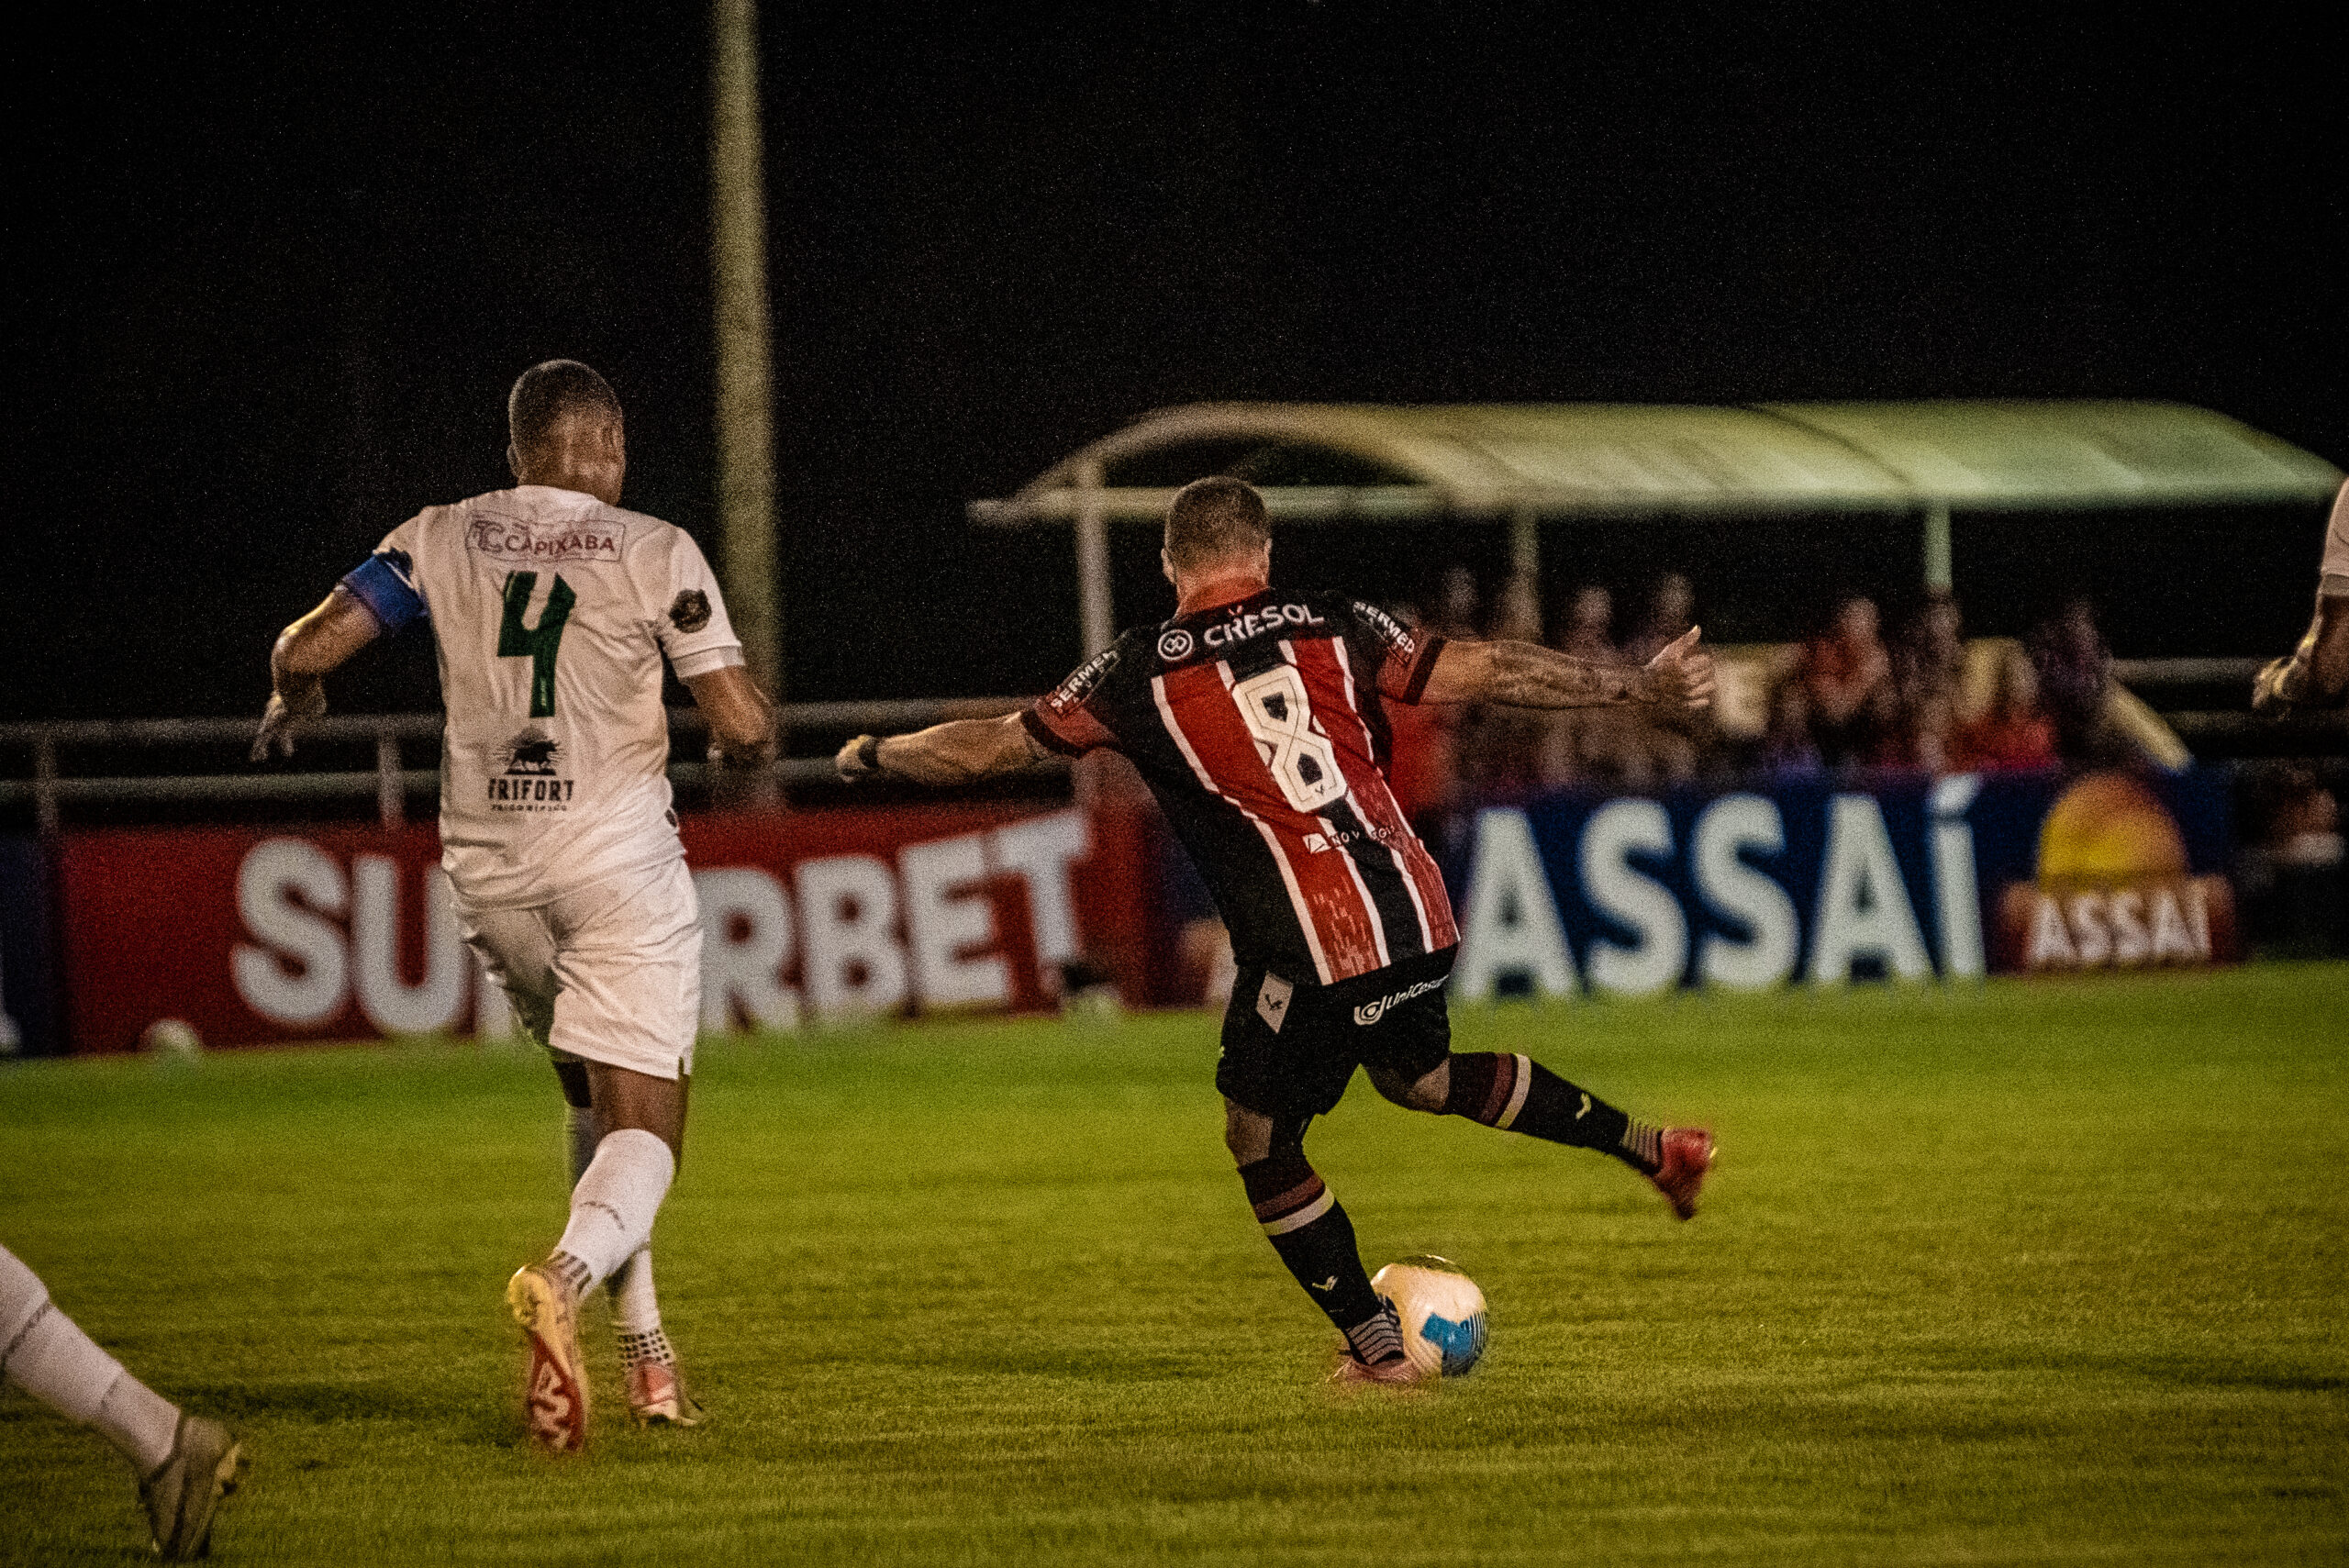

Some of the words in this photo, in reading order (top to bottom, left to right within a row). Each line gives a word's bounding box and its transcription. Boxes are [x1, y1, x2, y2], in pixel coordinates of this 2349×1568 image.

[505, 534, 615, 556] CAPIXABA
[496, 570, 577, 717] 4
[1204, 604, 1325, 646] CRESOL
[488, 778, 574, 802] FRIFORT
[1232, 663, 1348, 813] 8
[229, 811, 1091, 1036] SURBET
[1454, 773, 1987, 1001] ASSAÍ
